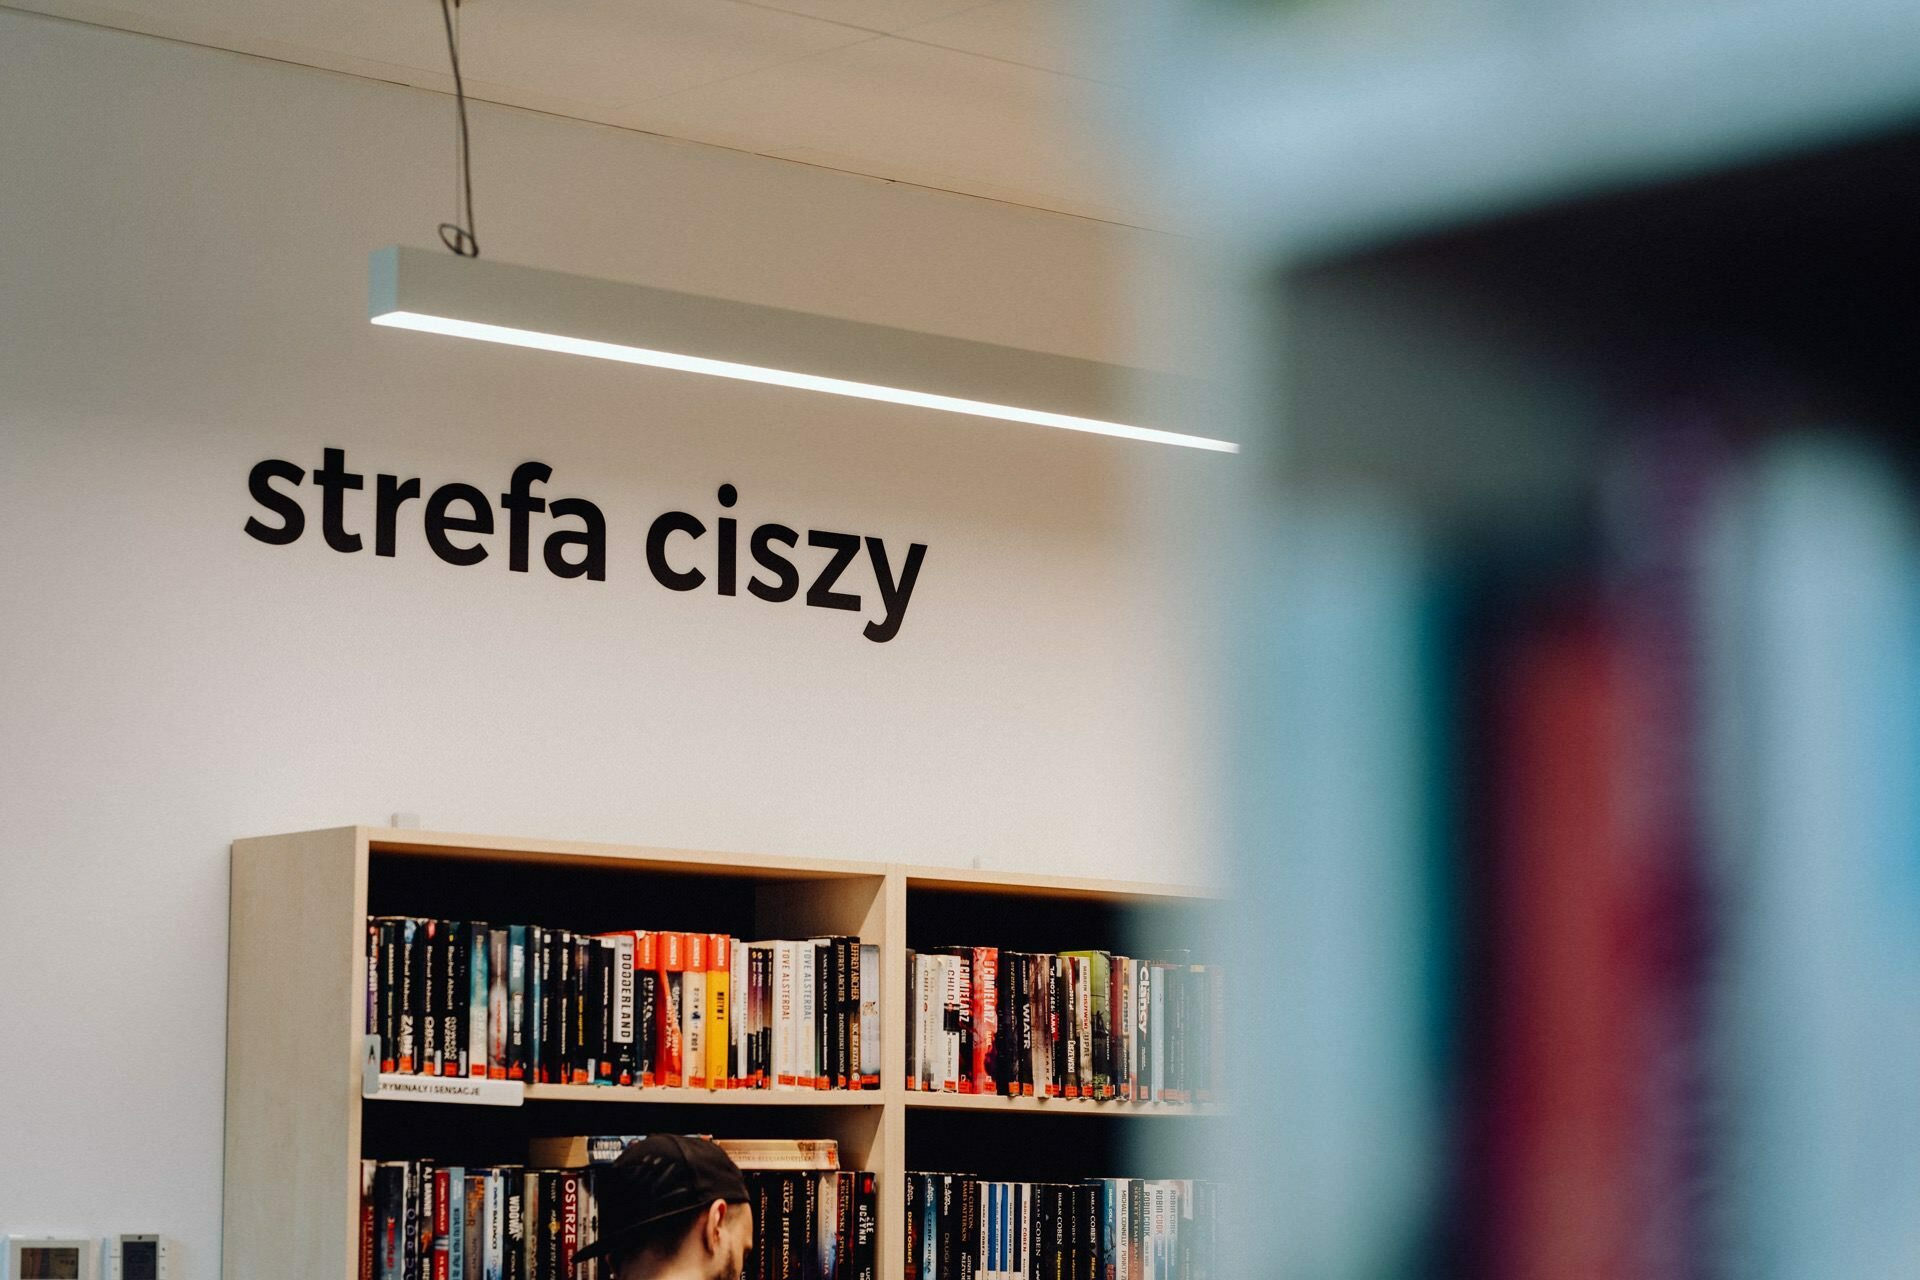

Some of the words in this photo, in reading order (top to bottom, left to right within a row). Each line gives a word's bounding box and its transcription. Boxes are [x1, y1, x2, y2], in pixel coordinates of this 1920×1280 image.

[244, 447, 606, 581] strefa
[646, 483, 928, 643] ciszy
[781, 949, 790, 970] TOVE
[803, 949, 812, 970] TOVE
[850, 943, 860, 970] JEFFREY
[781, 972, 790, 1021] ALSTERDAL
[803, 972, 812, 1021] ALSTERDAL
[851, 971, 859, 1000] ARCHER
[947, 969, 955, 1001] CHILD
[959, 966, 970, 1022] CHMIELARZ
[983, 968, 995, 1023] CHMIELARZ
[1138, 966, 1150, 1034] Clancy
[1022, 1003, 1030, 1049] WIATR
[434, 1085, 481, 1096] SENSACJE
[423, 1167, 432, 1181] A.J.
[423, 1182, 432, 1217] BANNER
[509, 1195, 520, 1235] WDOWA
[565, 1179, 576, 1244] OSTRZE
[782, 1180, 790, 1214] KLUCZ
[859, 1204, 867, 1245] UCZYNKI
[782, 1217, 790, 1280] JEFFERSONA
